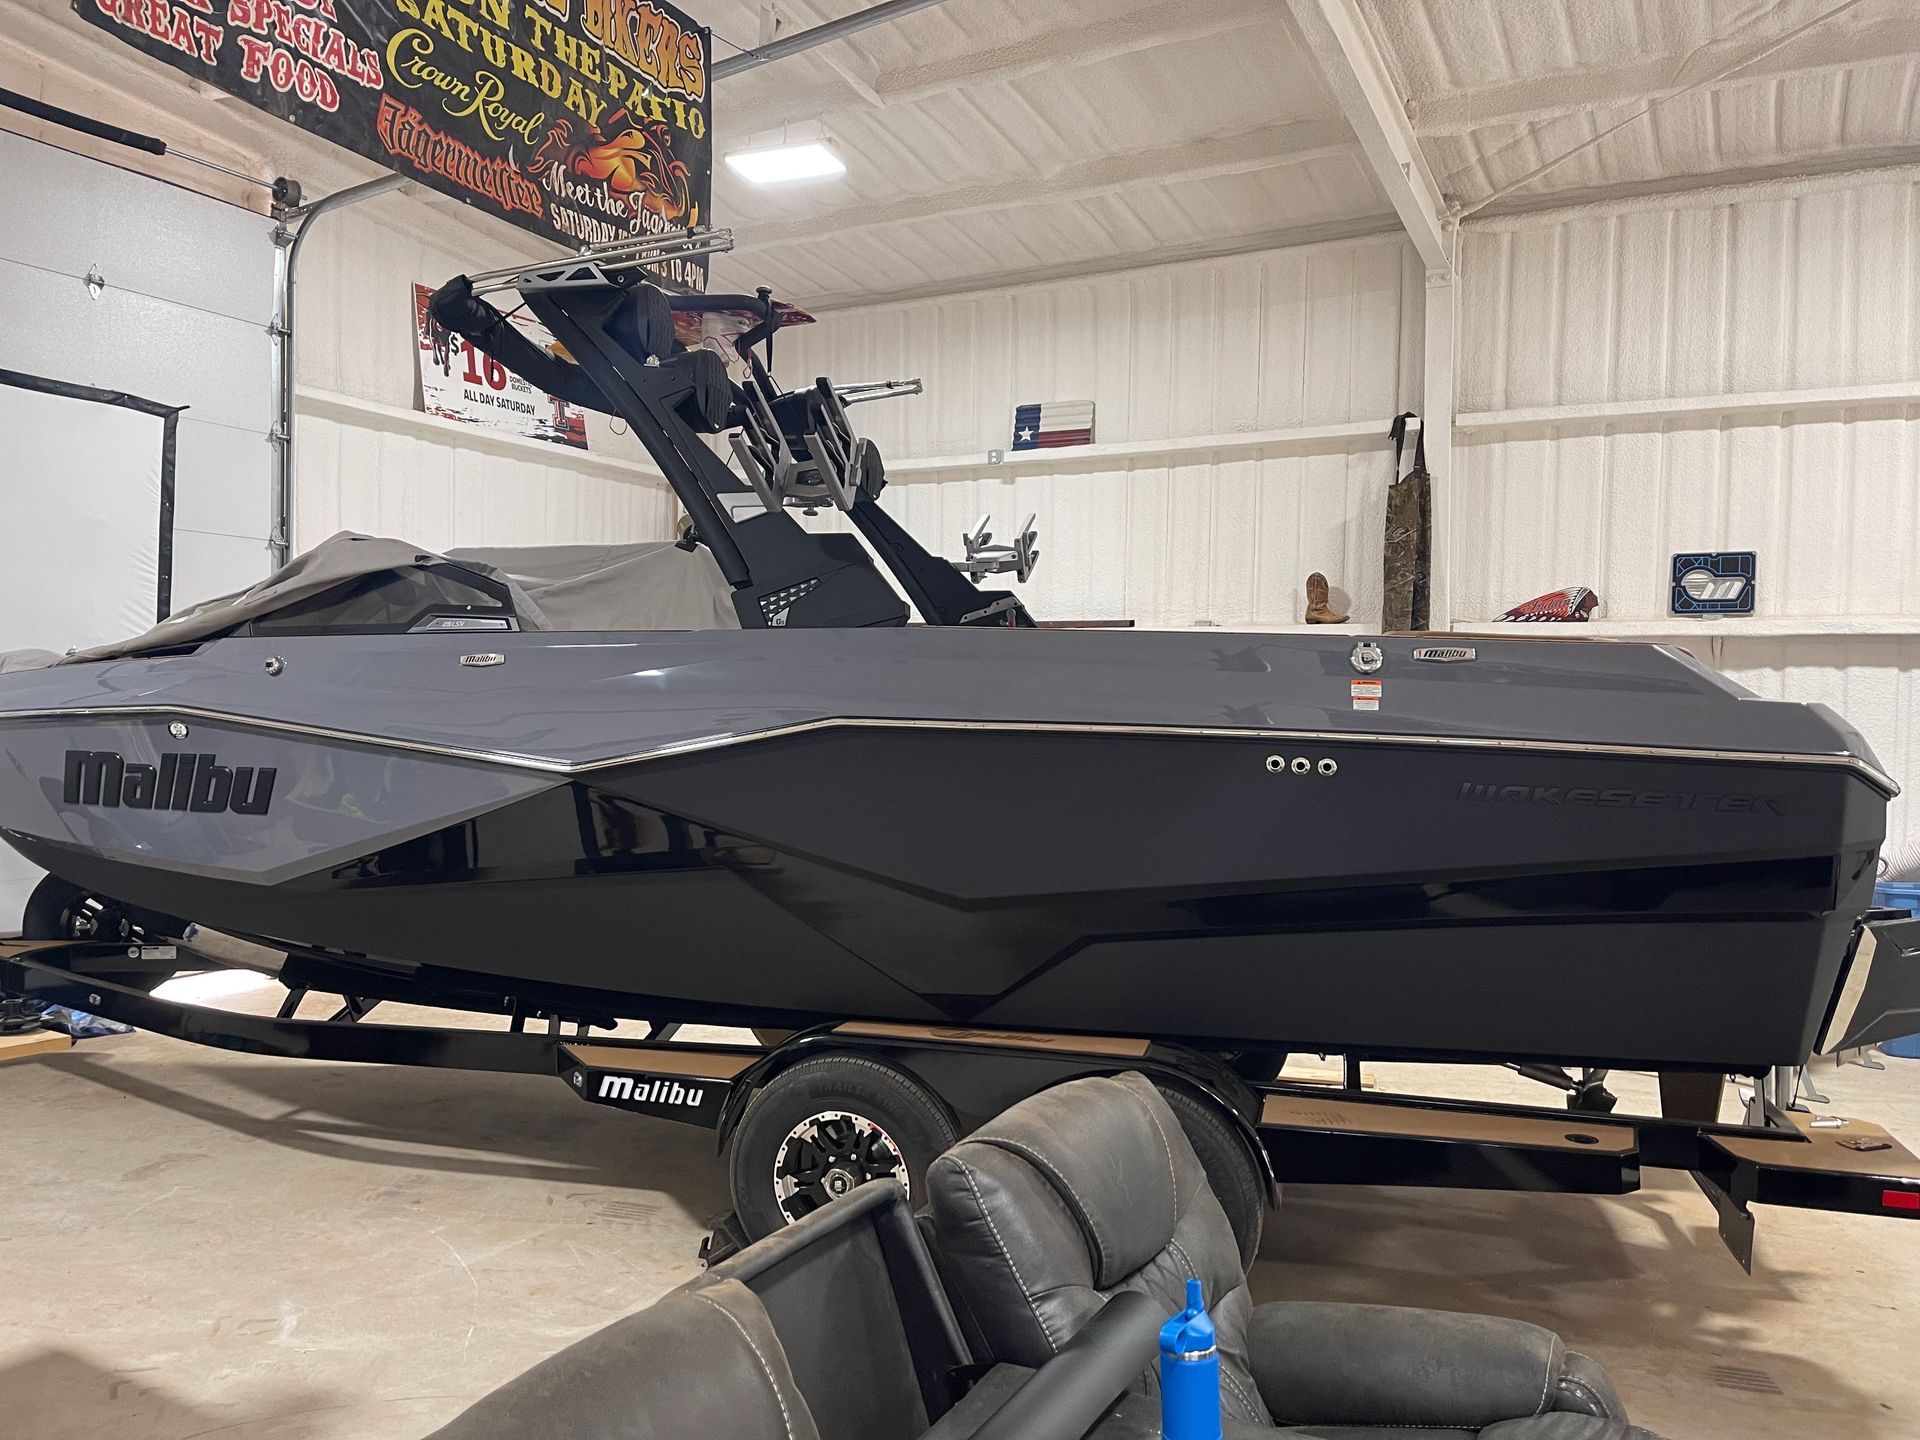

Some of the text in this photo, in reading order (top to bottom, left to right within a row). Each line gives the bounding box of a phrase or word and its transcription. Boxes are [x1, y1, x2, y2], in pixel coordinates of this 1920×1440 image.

[228, 0, 384, 89] SPECIALS
[238, 35, 340, 112] FOOD
[386, 28, 545, 145] Crown Royal
[525, 4, 602, 84] THE
[607, 62, 706, 139] PATIO
[542, 160, 595, 207] Meet
[594, 182, 629, 218] the
[550, 202, 615, 243] SATURDAY
[671, 259, 682, 283] TO
[684, 262, 705, 292] 4PM
[464, 388, 536, 416] ALL DAY SATURDAY
[511, 383, 532, 394] BUCKETS
[465, 654, 497, 663] Malibu
[1423, 648, 1468, 658] Malibu
[598, 1075, 704, 1107] Malibu
